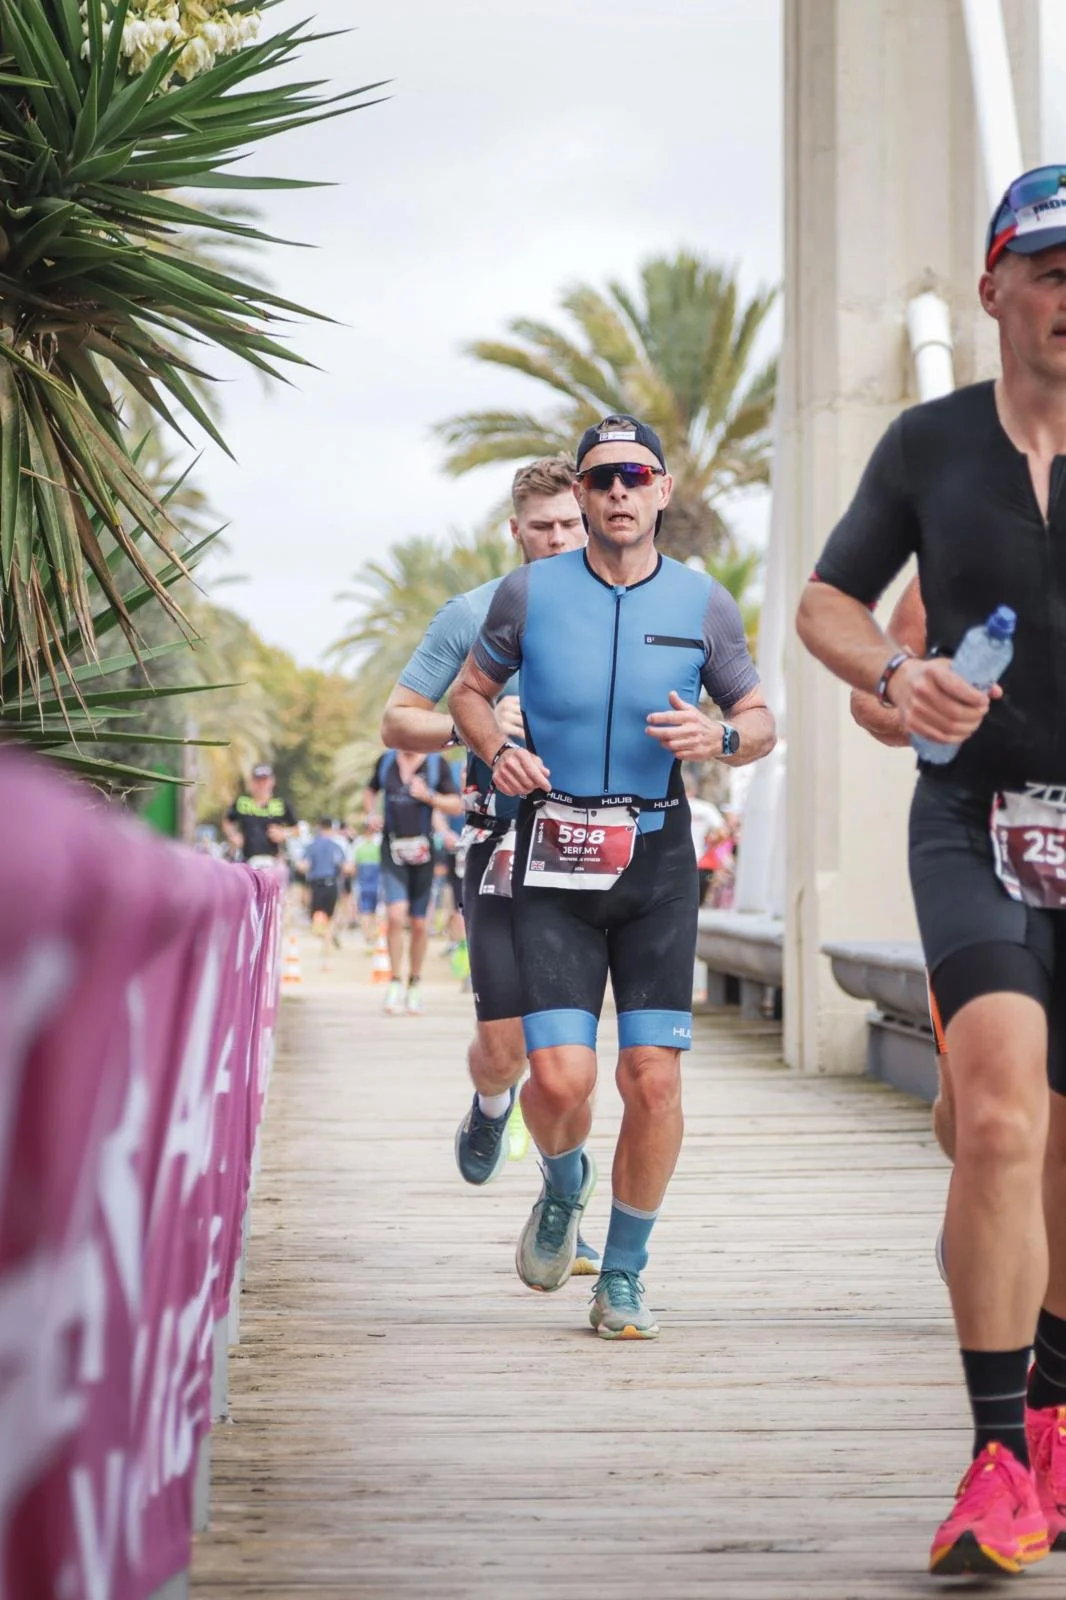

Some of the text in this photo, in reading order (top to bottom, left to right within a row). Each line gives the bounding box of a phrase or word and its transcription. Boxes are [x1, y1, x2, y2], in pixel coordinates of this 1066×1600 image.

[601, 796, 633, 805] HUUB
[654, 798, 680, 809] HUUB
[558, 824, 606, 844] 598
